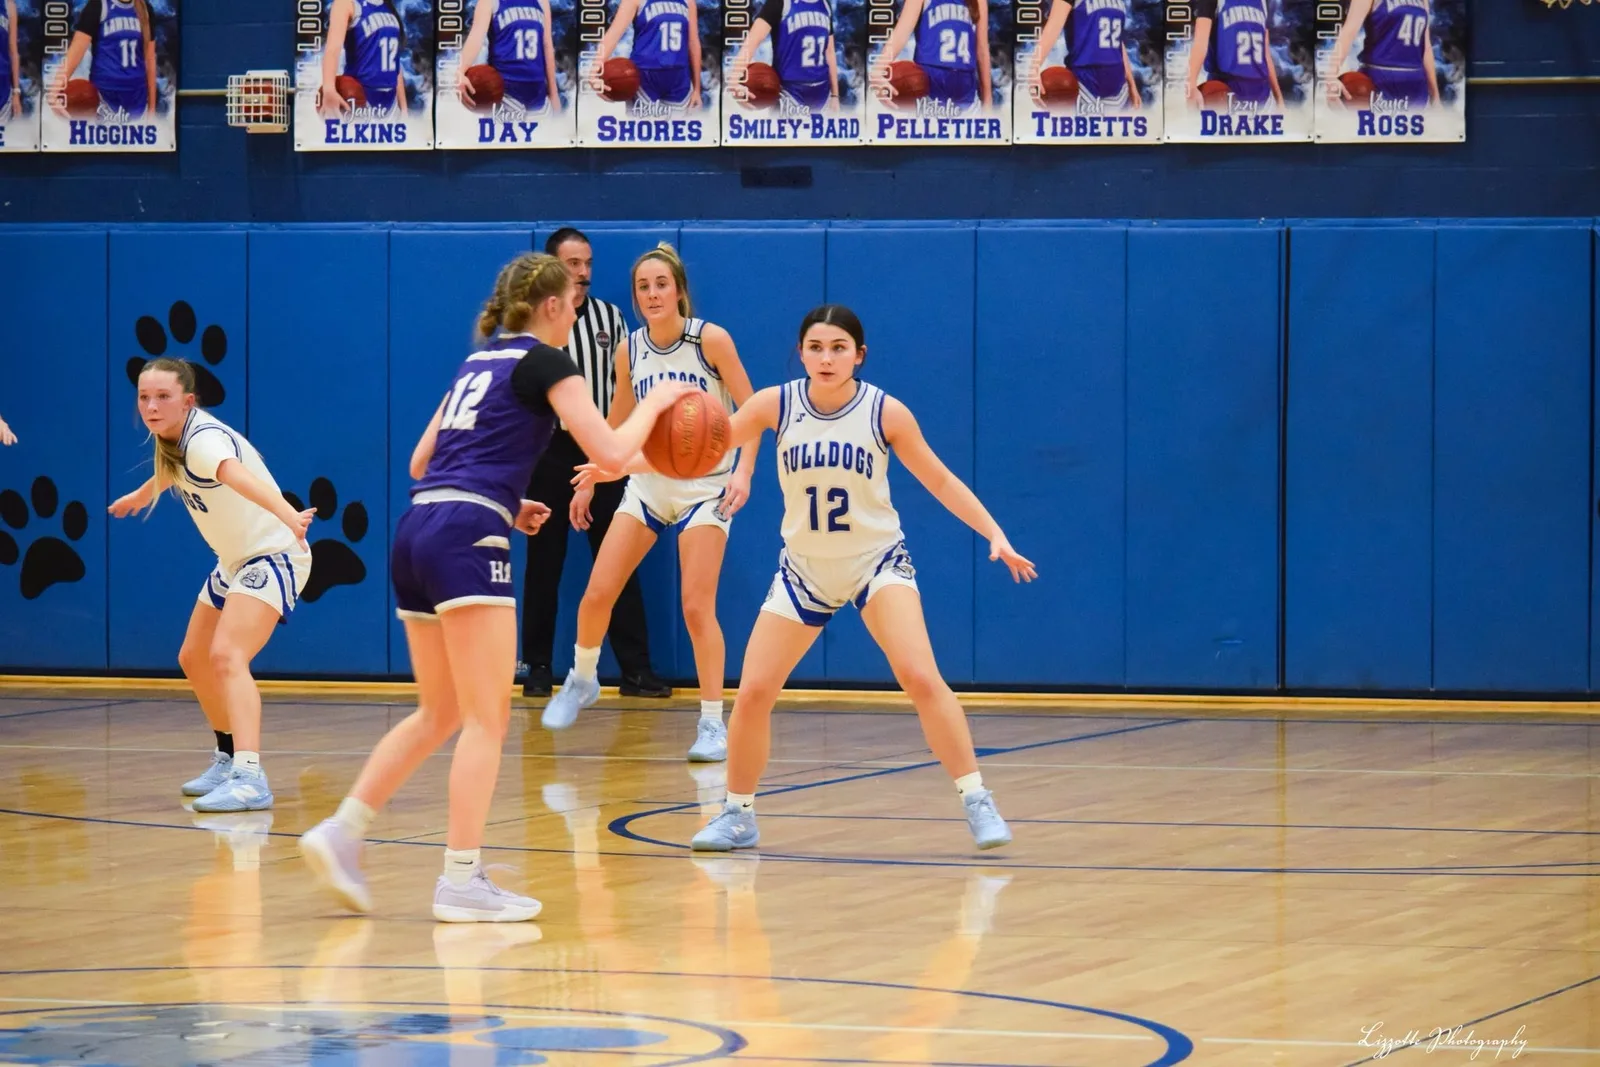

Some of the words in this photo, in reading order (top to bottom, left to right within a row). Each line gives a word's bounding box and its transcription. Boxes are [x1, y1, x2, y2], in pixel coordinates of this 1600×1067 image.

[659, 21, 682, 52] 15
[1099, 16, 1121, 49] 22
[1397, 14, 1426, 47] 40
[119, 39, 138, 67] 11
[379, 37, 399, 72] 12
[513, 29, 538, 60] 13
[802, 35, 826, 66] 21
[940, 28, 971, 64] 24
[1236, 31, 1263, 64] 25
[632, 99, 673, 121] Ashley
[779, 98, 811, 118] Nora
[915, 97, 961, 118] Natalie
[69, 120, 157, 145] HIGGINS
[325, 119, 407, 144] ELKINS
[478, 118, 538, 143] DAY
[597, 115, 703, 142] SHORES
[729, 113, 860, 139] SMILEY-BARD
[877, 113, 1001, 139] PELLETIER
[1031, 111, 1148, 137] TIBBETTS
[1200, 110, 1284, 136] DRAKE
[1357, 110, 1425, 136] ROSS
[440, 371, 493, 430] 12
[783, 440, 874, 480] BULLDOGS
[805, 486, 851, 532] 12
